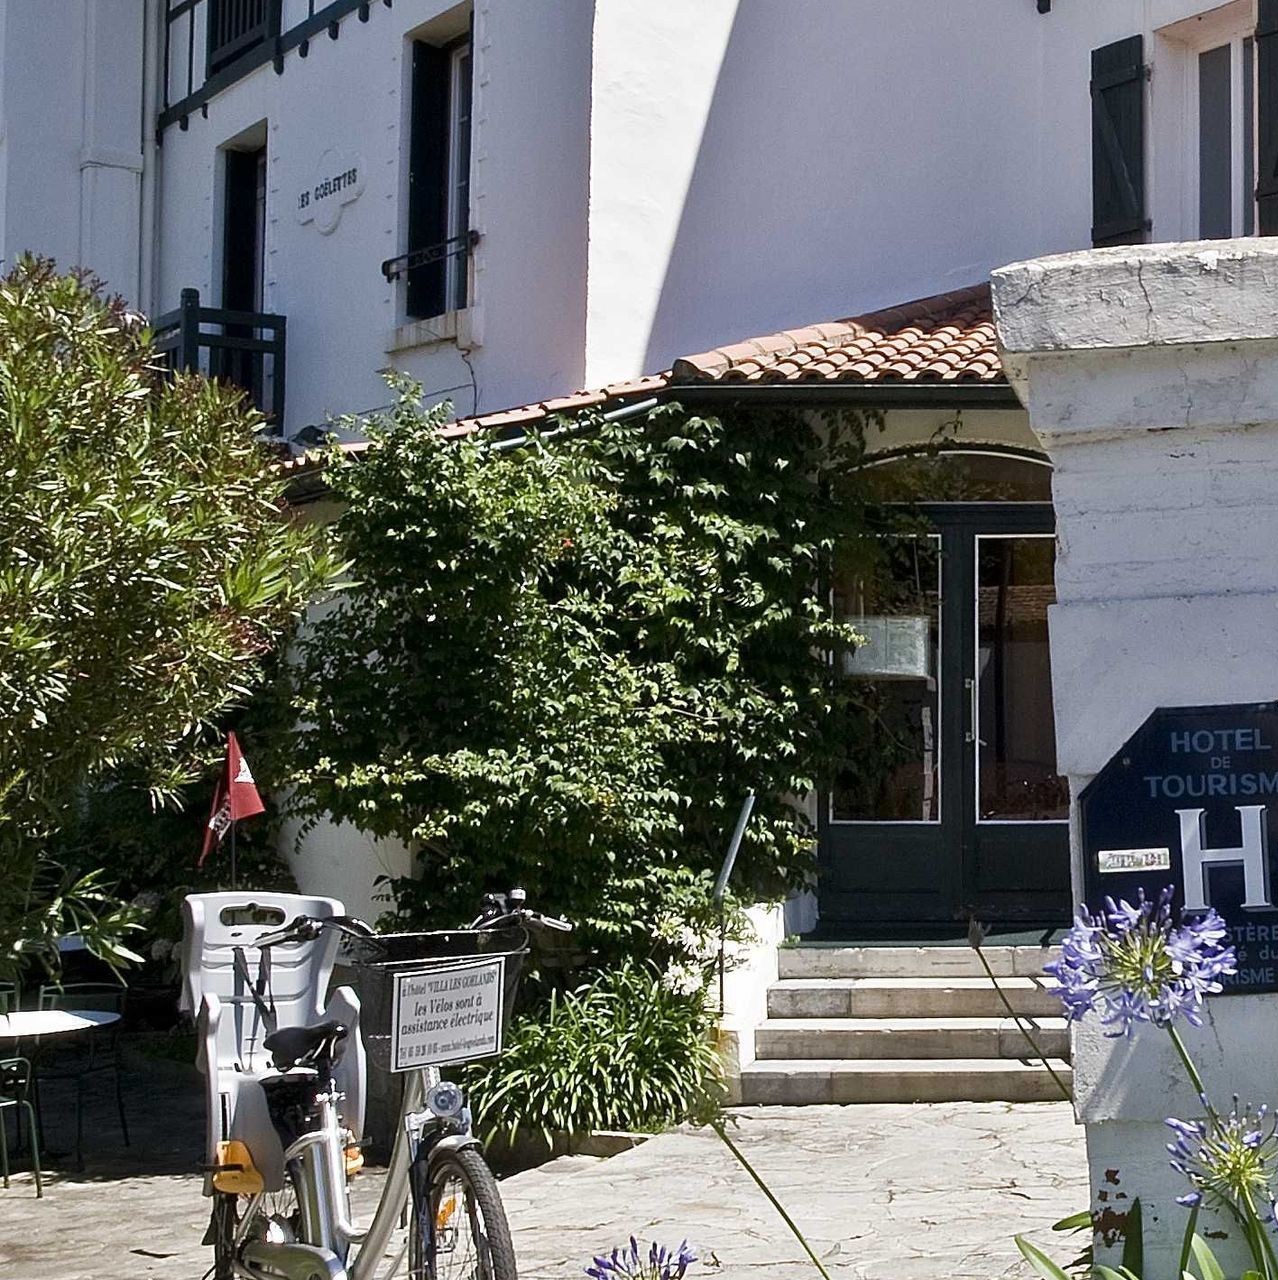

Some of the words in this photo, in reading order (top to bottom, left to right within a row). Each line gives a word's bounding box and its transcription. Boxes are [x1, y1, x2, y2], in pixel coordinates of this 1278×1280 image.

[1170, 729, 1272, 754] HOTEL
[1210, 755, 1231, 769] DE
[414, 1001, 427, 1017] les
[430, 997, 453, 1014] Vélos
[455, 995, 474, 1010] sont
[401, 1018, 449, 1035] assistance
[450, 1009, 494, 1028] électrique
